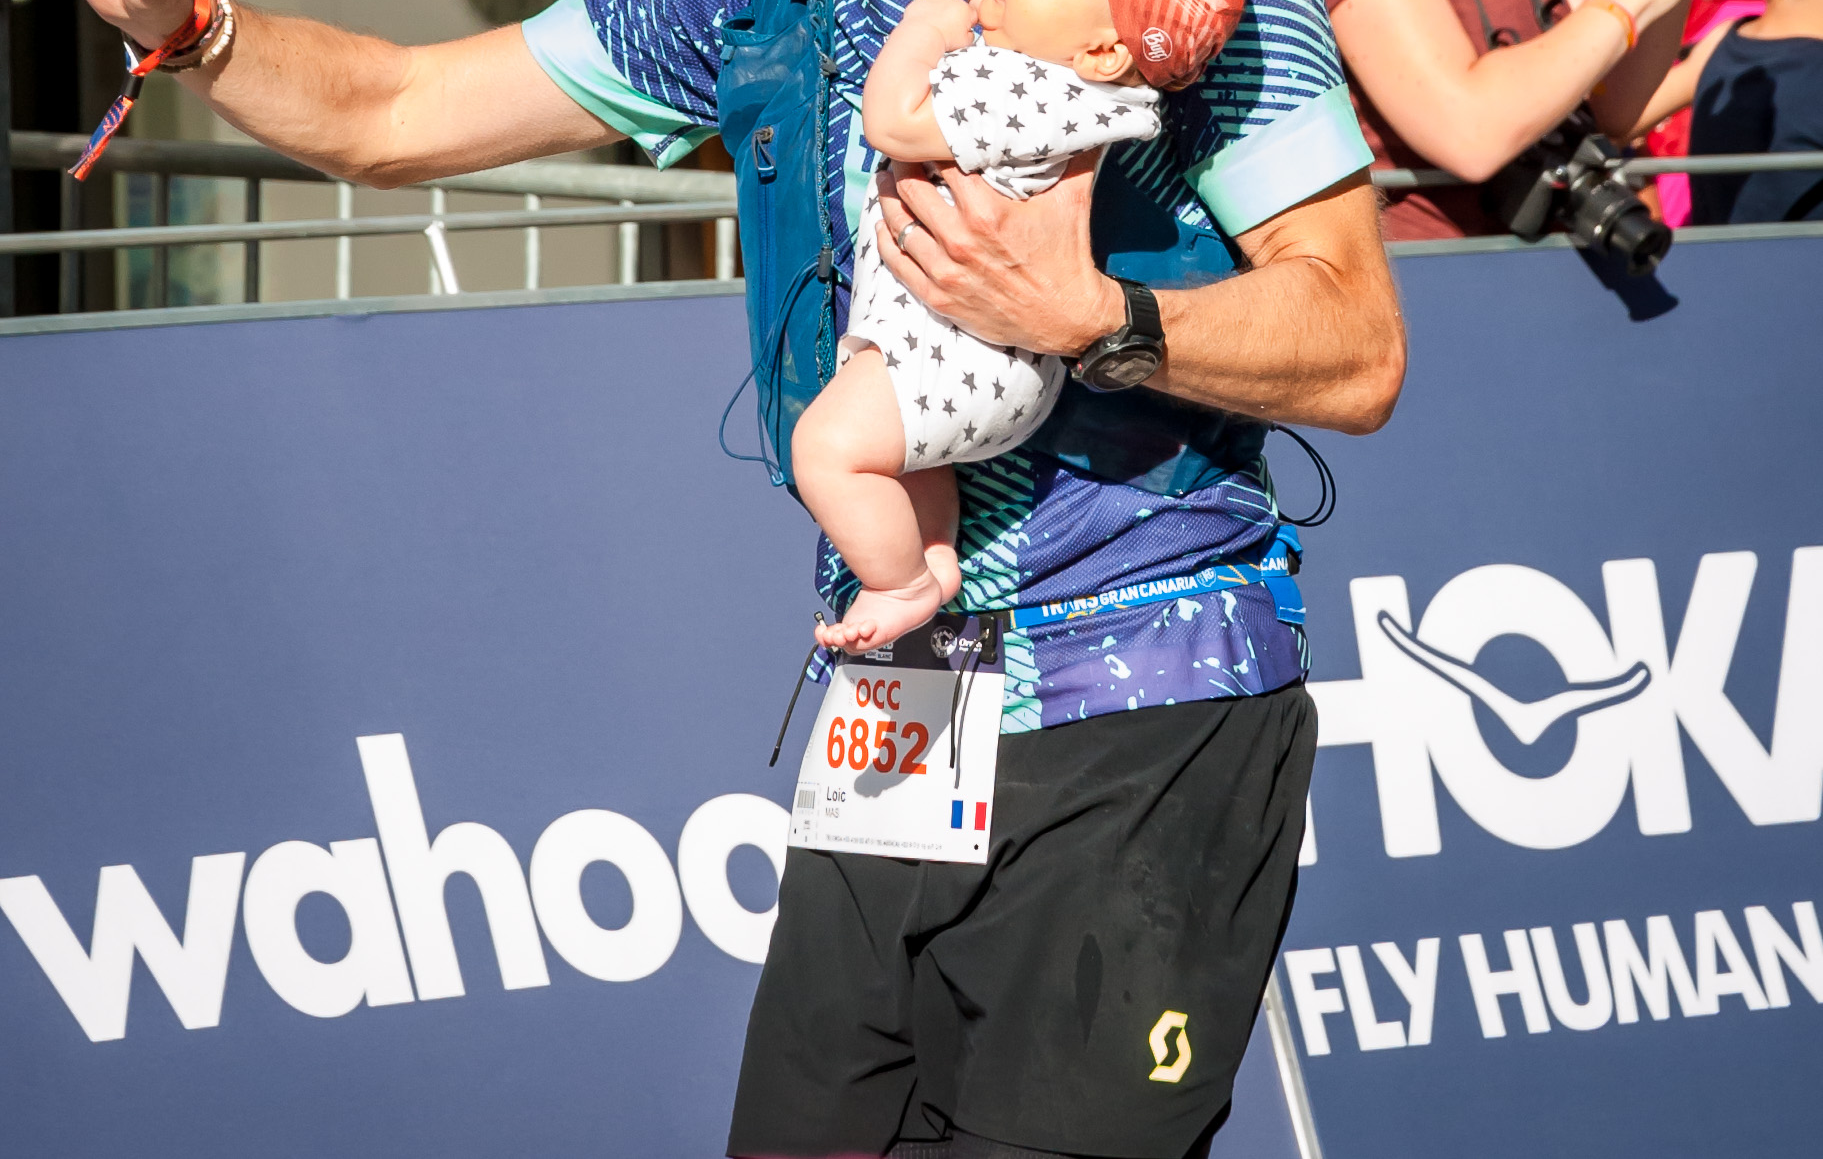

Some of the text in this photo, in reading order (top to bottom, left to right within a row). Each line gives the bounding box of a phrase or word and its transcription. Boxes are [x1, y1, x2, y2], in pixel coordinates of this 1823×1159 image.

[827, 716, 929, 775] 6852
[856, 678, 901, 711] OCC
[0, 732, 792, 1043] wahoo
[1284, 900, 1823, 1056] FLY HUMAN
